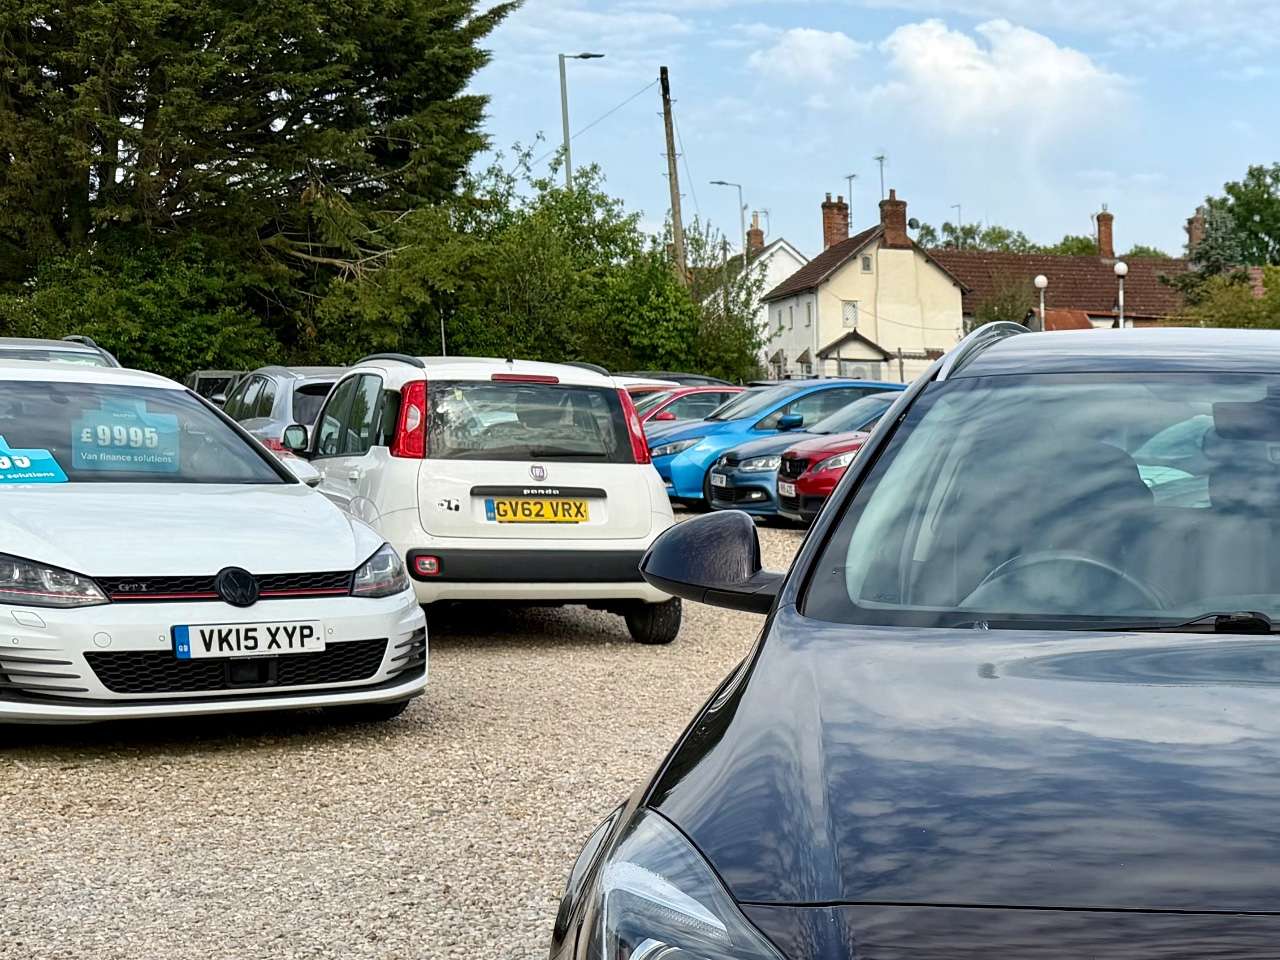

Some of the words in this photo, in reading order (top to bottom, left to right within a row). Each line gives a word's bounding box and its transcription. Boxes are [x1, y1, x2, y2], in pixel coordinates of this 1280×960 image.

[80, 452, 98, 461] Van
[100, 452, 131, 463] finance
[133, 453, 173, 464] solutions
[496, 501, 545, 518] GV62
[549, 501, 585, 519] VRX
[200, 627, 259, 653] VK15
[266, 624, 314, 649] XYP
